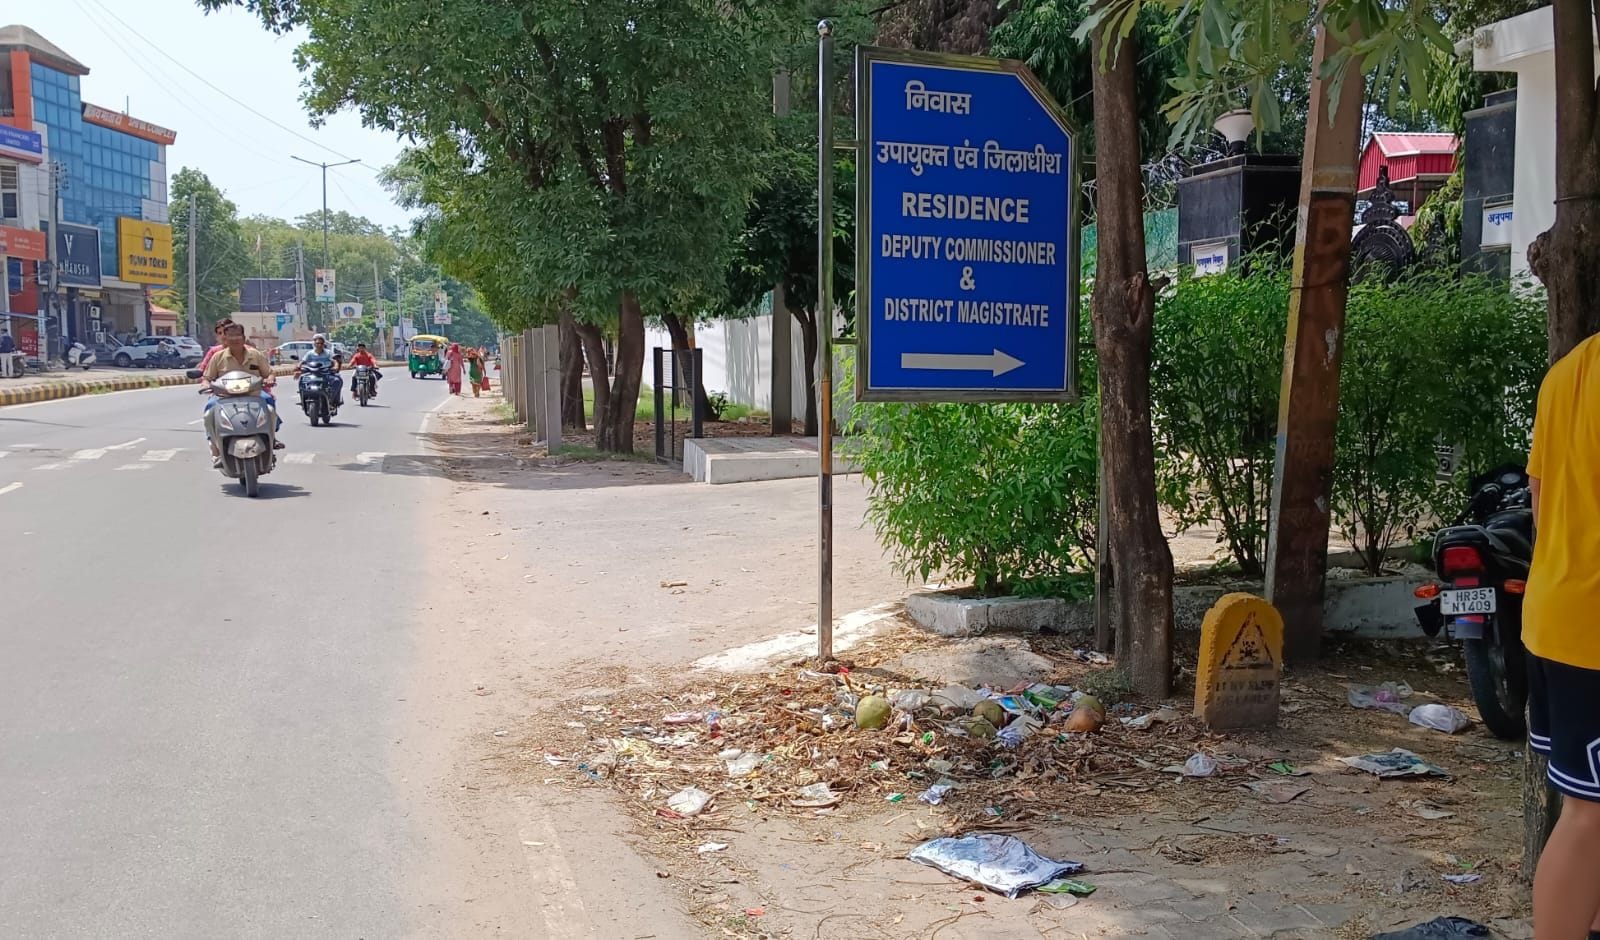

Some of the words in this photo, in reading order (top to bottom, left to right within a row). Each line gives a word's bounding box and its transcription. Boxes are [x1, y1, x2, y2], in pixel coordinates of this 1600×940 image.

[905, 80, 971, 115] निवास
[876, 141, 949, 176] उपायुक्त
[983, 139, 1062, 174] जिलाधीश
[902, 192, 1029, 223] RESIDENCE
[882, 234, 941, 259] DEPUTY
[945, 238, 1056, 265] COMMISSIONER
[960, 266, 976, 291] &
[884, 298, 953, 322] DISTRICT
[957, 302, 1049, 327] MAGISTRATE
[1452, 600, 1491, 612] N1409
[1456, 590, 1487, 602] HR35
